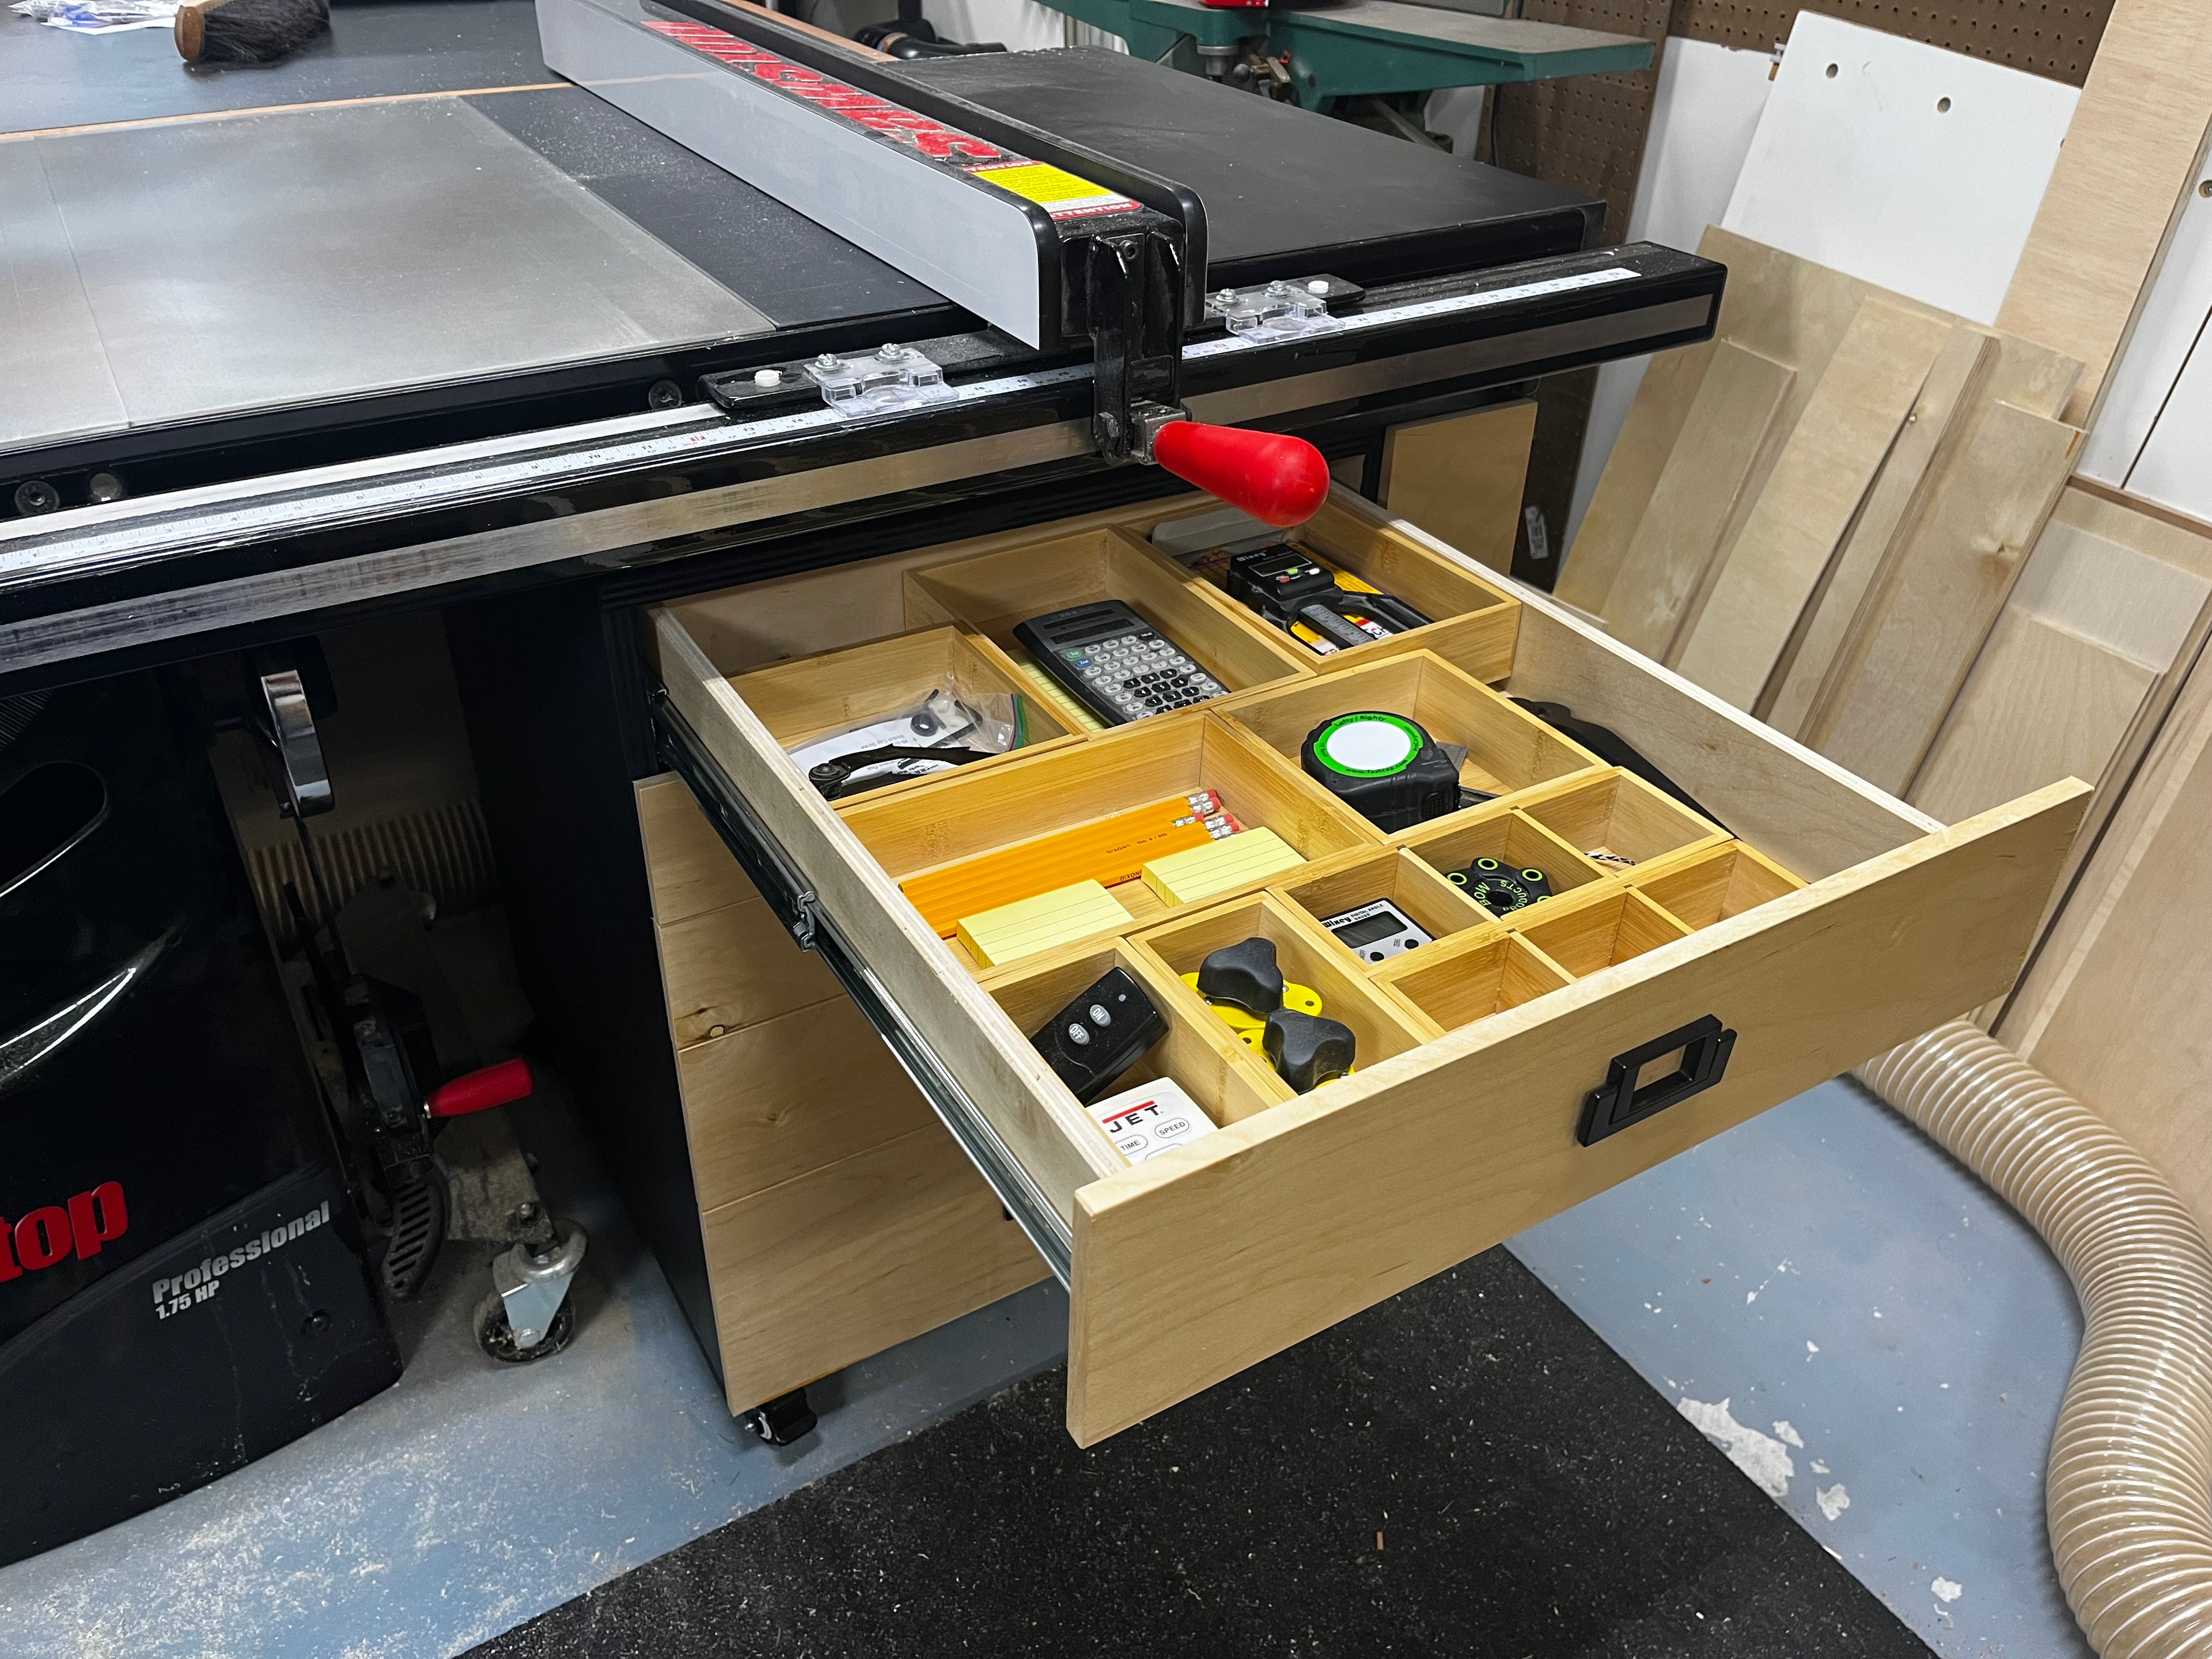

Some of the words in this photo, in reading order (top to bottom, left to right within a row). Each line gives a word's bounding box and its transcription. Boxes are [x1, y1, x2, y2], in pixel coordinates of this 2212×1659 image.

[1345, 759, 1408, 774] www.fastcap.com
[1474, 882, 1492, 906] BOW
[1500, 880, 1528, 911] PRODUCTS
[1368, 903, 1384, 912] ANGLE
[1354, 912, 1371, 921] GAUGE
[1092, 1007, 1105, 1021] ON
[1070, 1025, 1085, 1040] OFF
[1109, 1104, 1158, 1133] JET
[1159, 1121, 1186, 1135] SPEED
[1120, 1139, 1141, 1152] TIME
[151, 1200, 331, 1305] Professional
[155, 1294, 192, 1320] 1.75
[195, 1279, 220, 1304] HP
